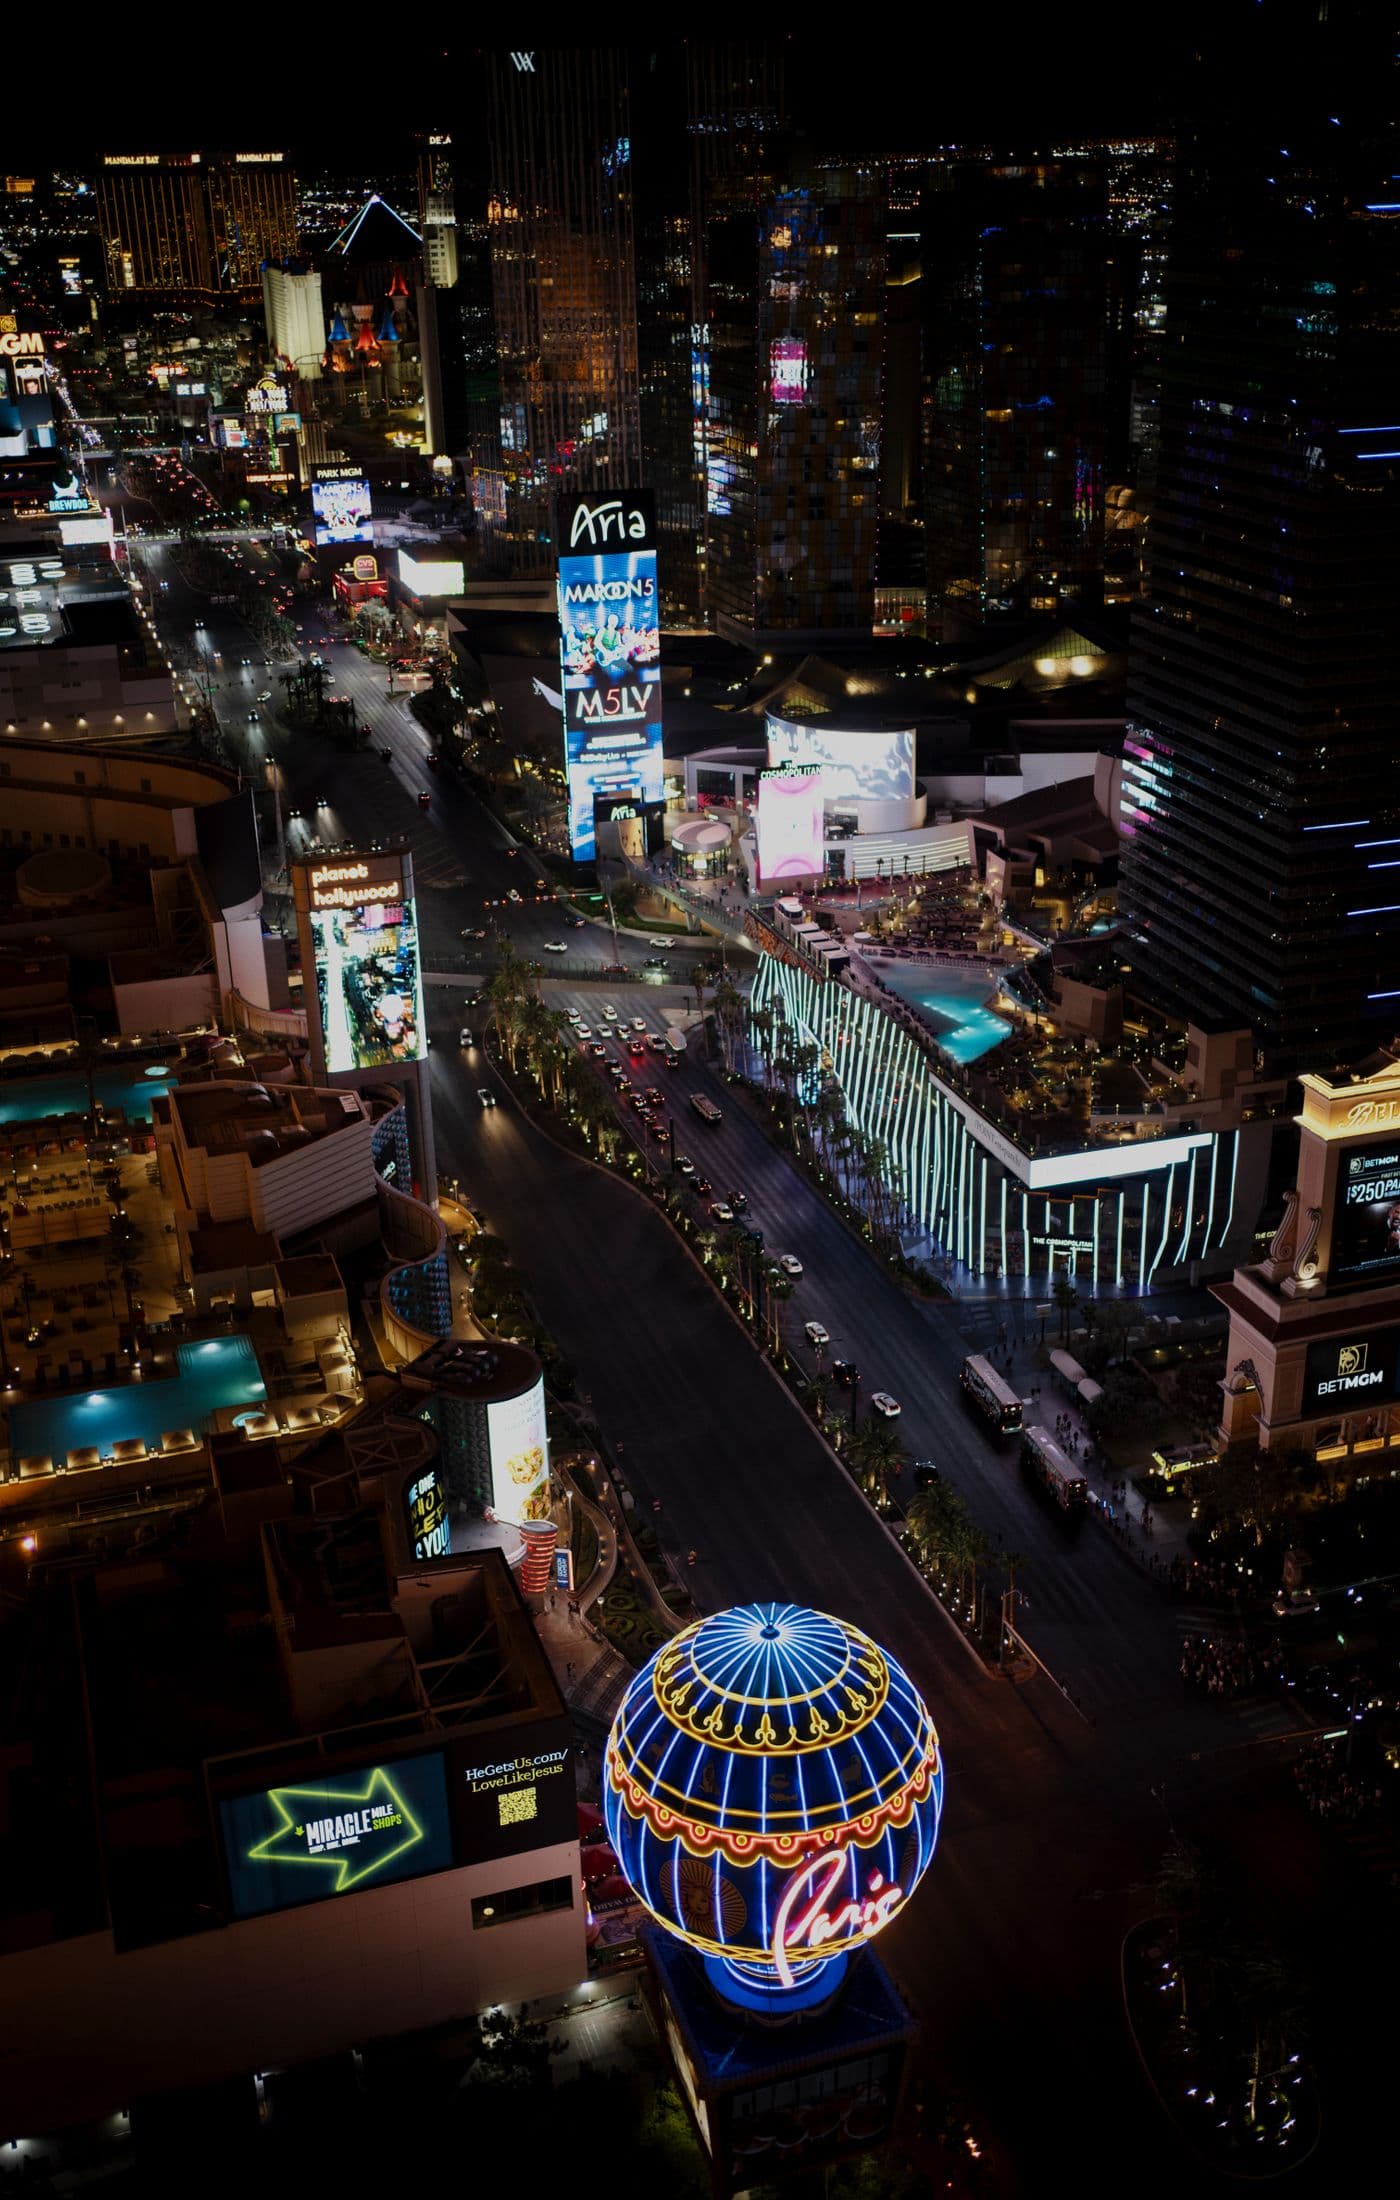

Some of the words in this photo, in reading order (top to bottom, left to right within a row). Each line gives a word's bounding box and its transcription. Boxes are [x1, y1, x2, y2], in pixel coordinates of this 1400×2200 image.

[317, 469, 339, 479] PARK
[340, 467, 363, 477] MGM
[48, 498, 89, 512] BREWDOG
[570, 500, 647, 548] Aria
[356, 560, 374, 568] CVS
[565, 579, 642, 604] MAROON
[643, 578, 655, 598] 5
[576, 684, 653, 718] M5LV
[760, 765, 823, 780] COSMOPOLITAN
[611, 805, 637, 822] Aria
[311, 863, 370, 888] planet
[313, 881, 399, 906] hollywood
[1364, 1155, 1399, 1169] BETMGM
[1350, 1180, 1385, 1204] $250
[1032, 1237, 1046, 1245] THE
[1046, 1238, 1093, 1248] COSMOPOLITAN
[1317, 1369, 1384, 1396] BETMGM
[465, 1748, 569, 1781] HeGetsUs.com/
[472, 1763, 564, 1793] LoveLikeJesus
[306, 1809, 373, 1847] MIRACLE
[371, 1804, 394, 1820] MILE
[373, 1813, 403, 1831] SHOPS
[775, 1849, 903, 1988] Paris
